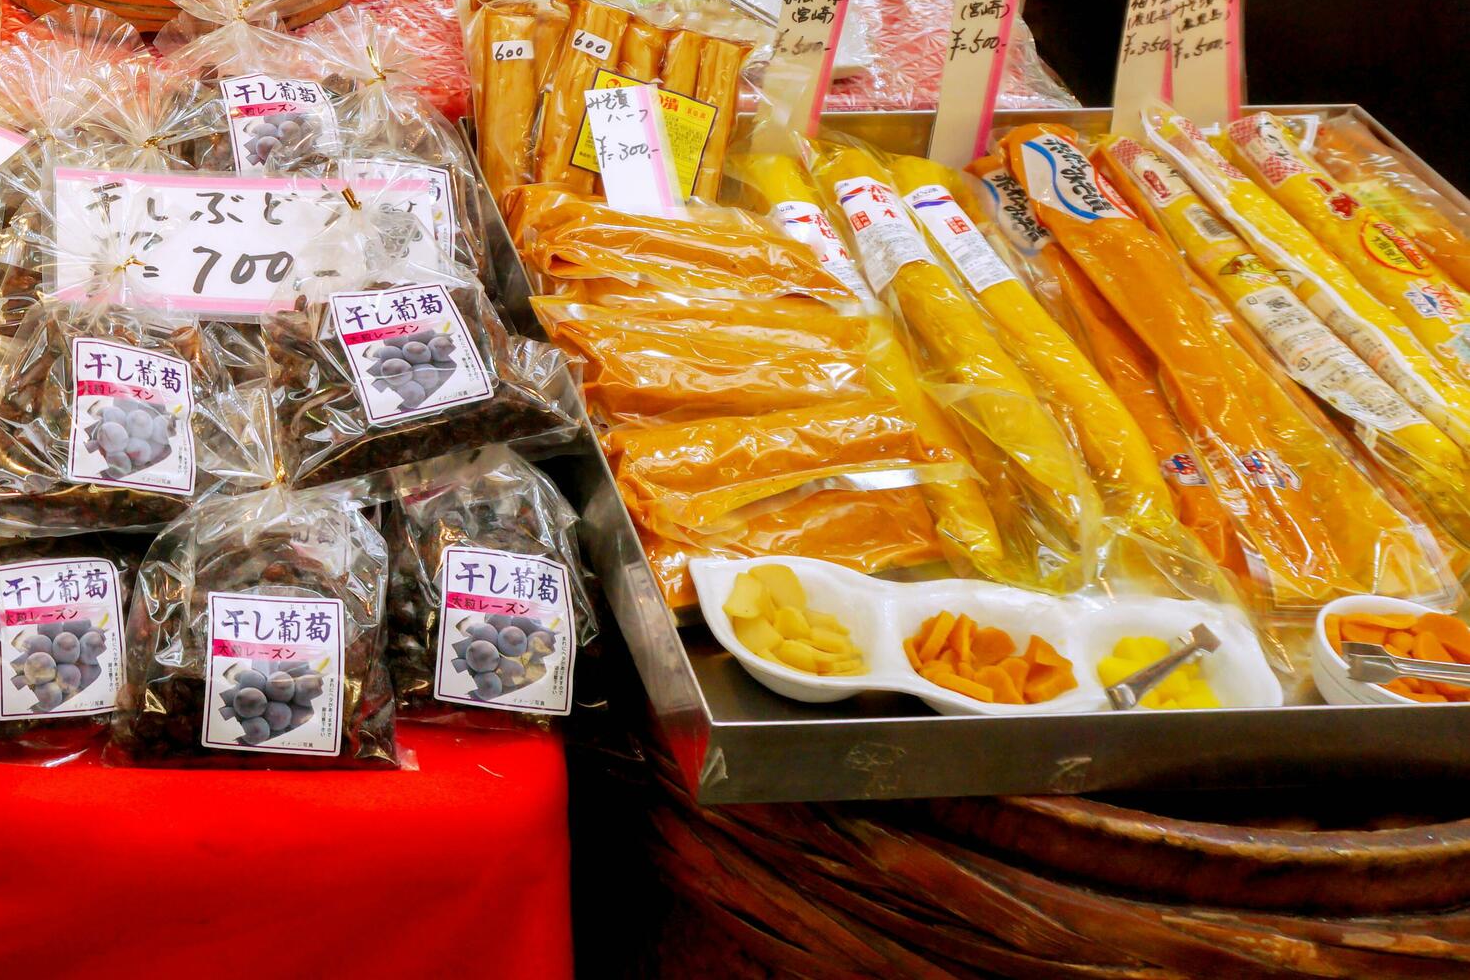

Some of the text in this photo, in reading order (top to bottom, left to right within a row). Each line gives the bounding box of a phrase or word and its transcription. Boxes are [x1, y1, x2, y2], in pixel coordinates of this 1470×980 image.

[494, 43, 524, 62] 600
[573, 33, 606, 55] 600
[233, 82, 318, 105] 干し葡萄
[345, 293, 444, 331] 干し葡萄
[84, 352, 182, 394] 干し葡萄
[2, 569, 109, 607] 干し葡萄
[455, 561, 559, 605] 干し葡萄
[5, 607, 79, 625] 大粒レーズン
[451, 596, 531, 616] 大粒レーズン
[221, 609, 332, 644] 干し葡萄
[217, 642, 297, 660] 大粒レーズン
